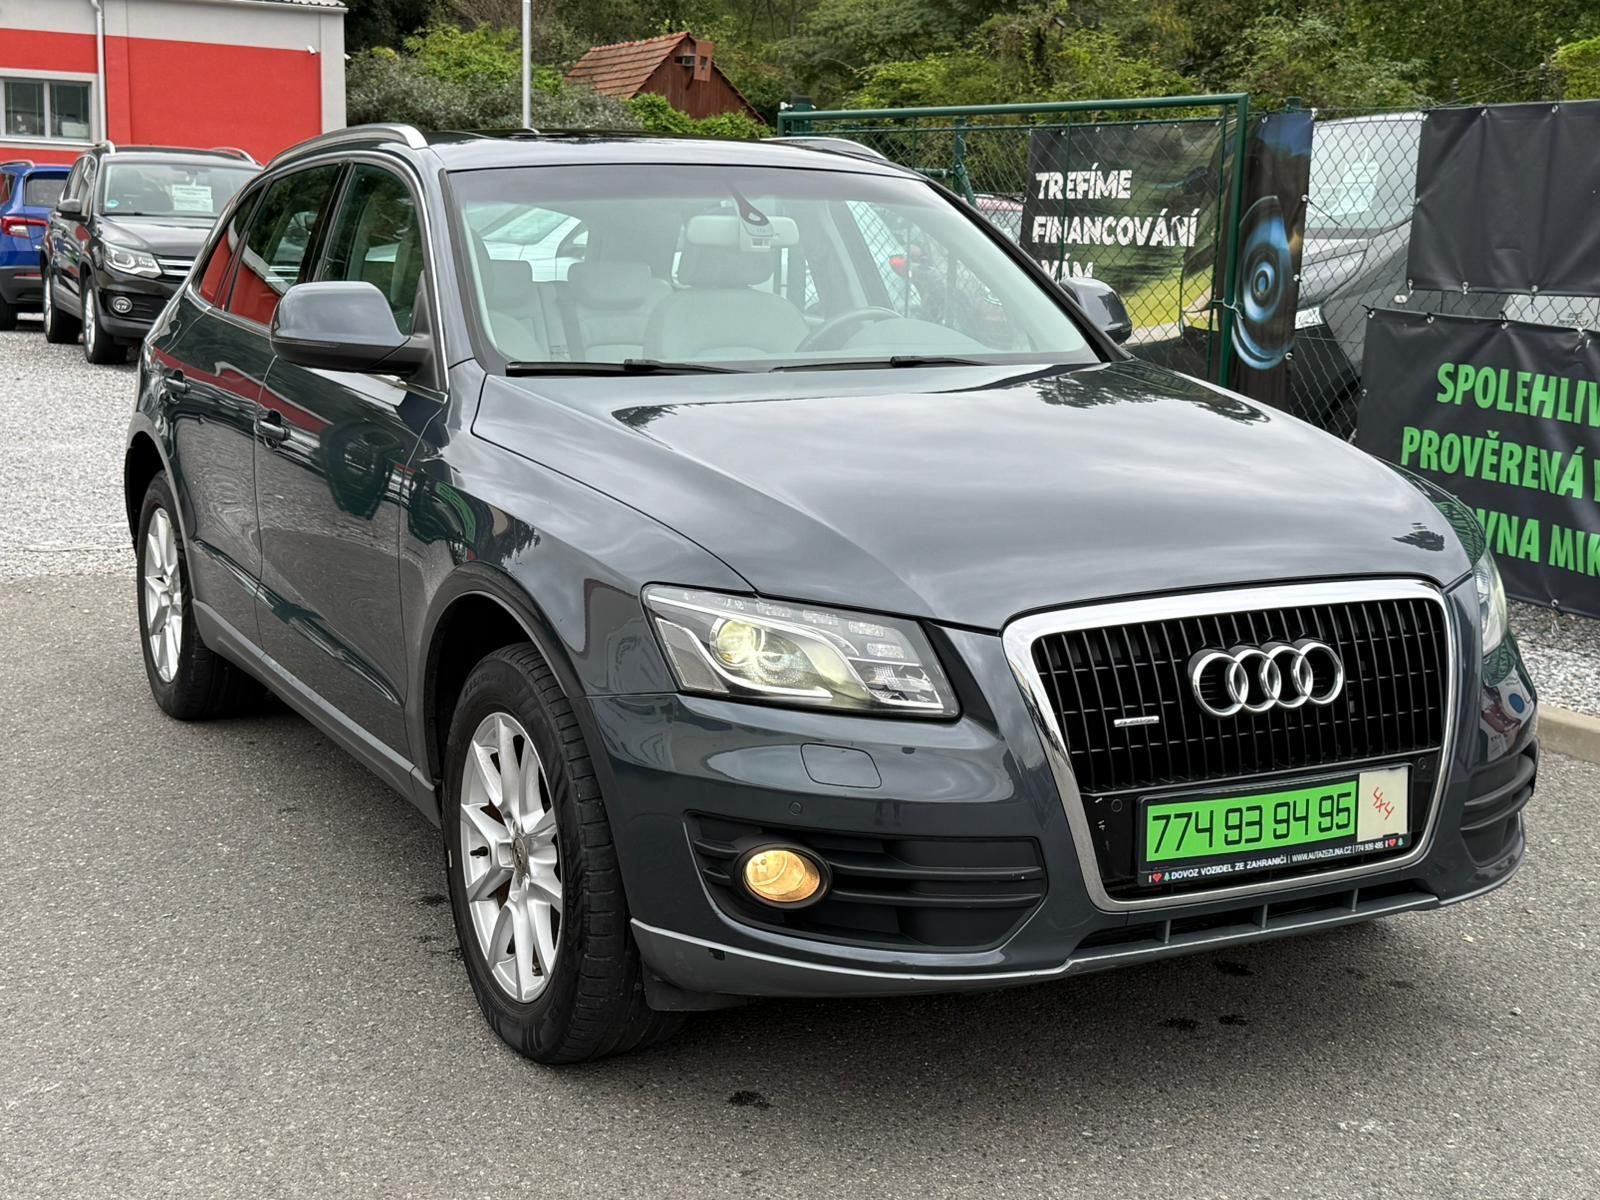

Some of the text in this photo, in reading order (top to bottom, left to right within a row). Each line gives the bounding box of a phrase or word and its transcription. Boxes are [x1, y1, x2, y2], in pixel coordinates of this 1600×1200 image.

[1035, 162, 1132, 200] TREFÍME
[1032, 208, 1200, 247] FINANCOVÁNÍ
[1401, 426, 1585, 499] PROVĚRENÁ
[1476, 508, 1540, 563] VNA
[1151, 791, 1352, 854] 774 93 94 95
[1171, 868, 1199, 880] DOVOZ
[1201, 863, 1234, 875] VOZIDEL
[1235, 861, 1245, 871] ZE
